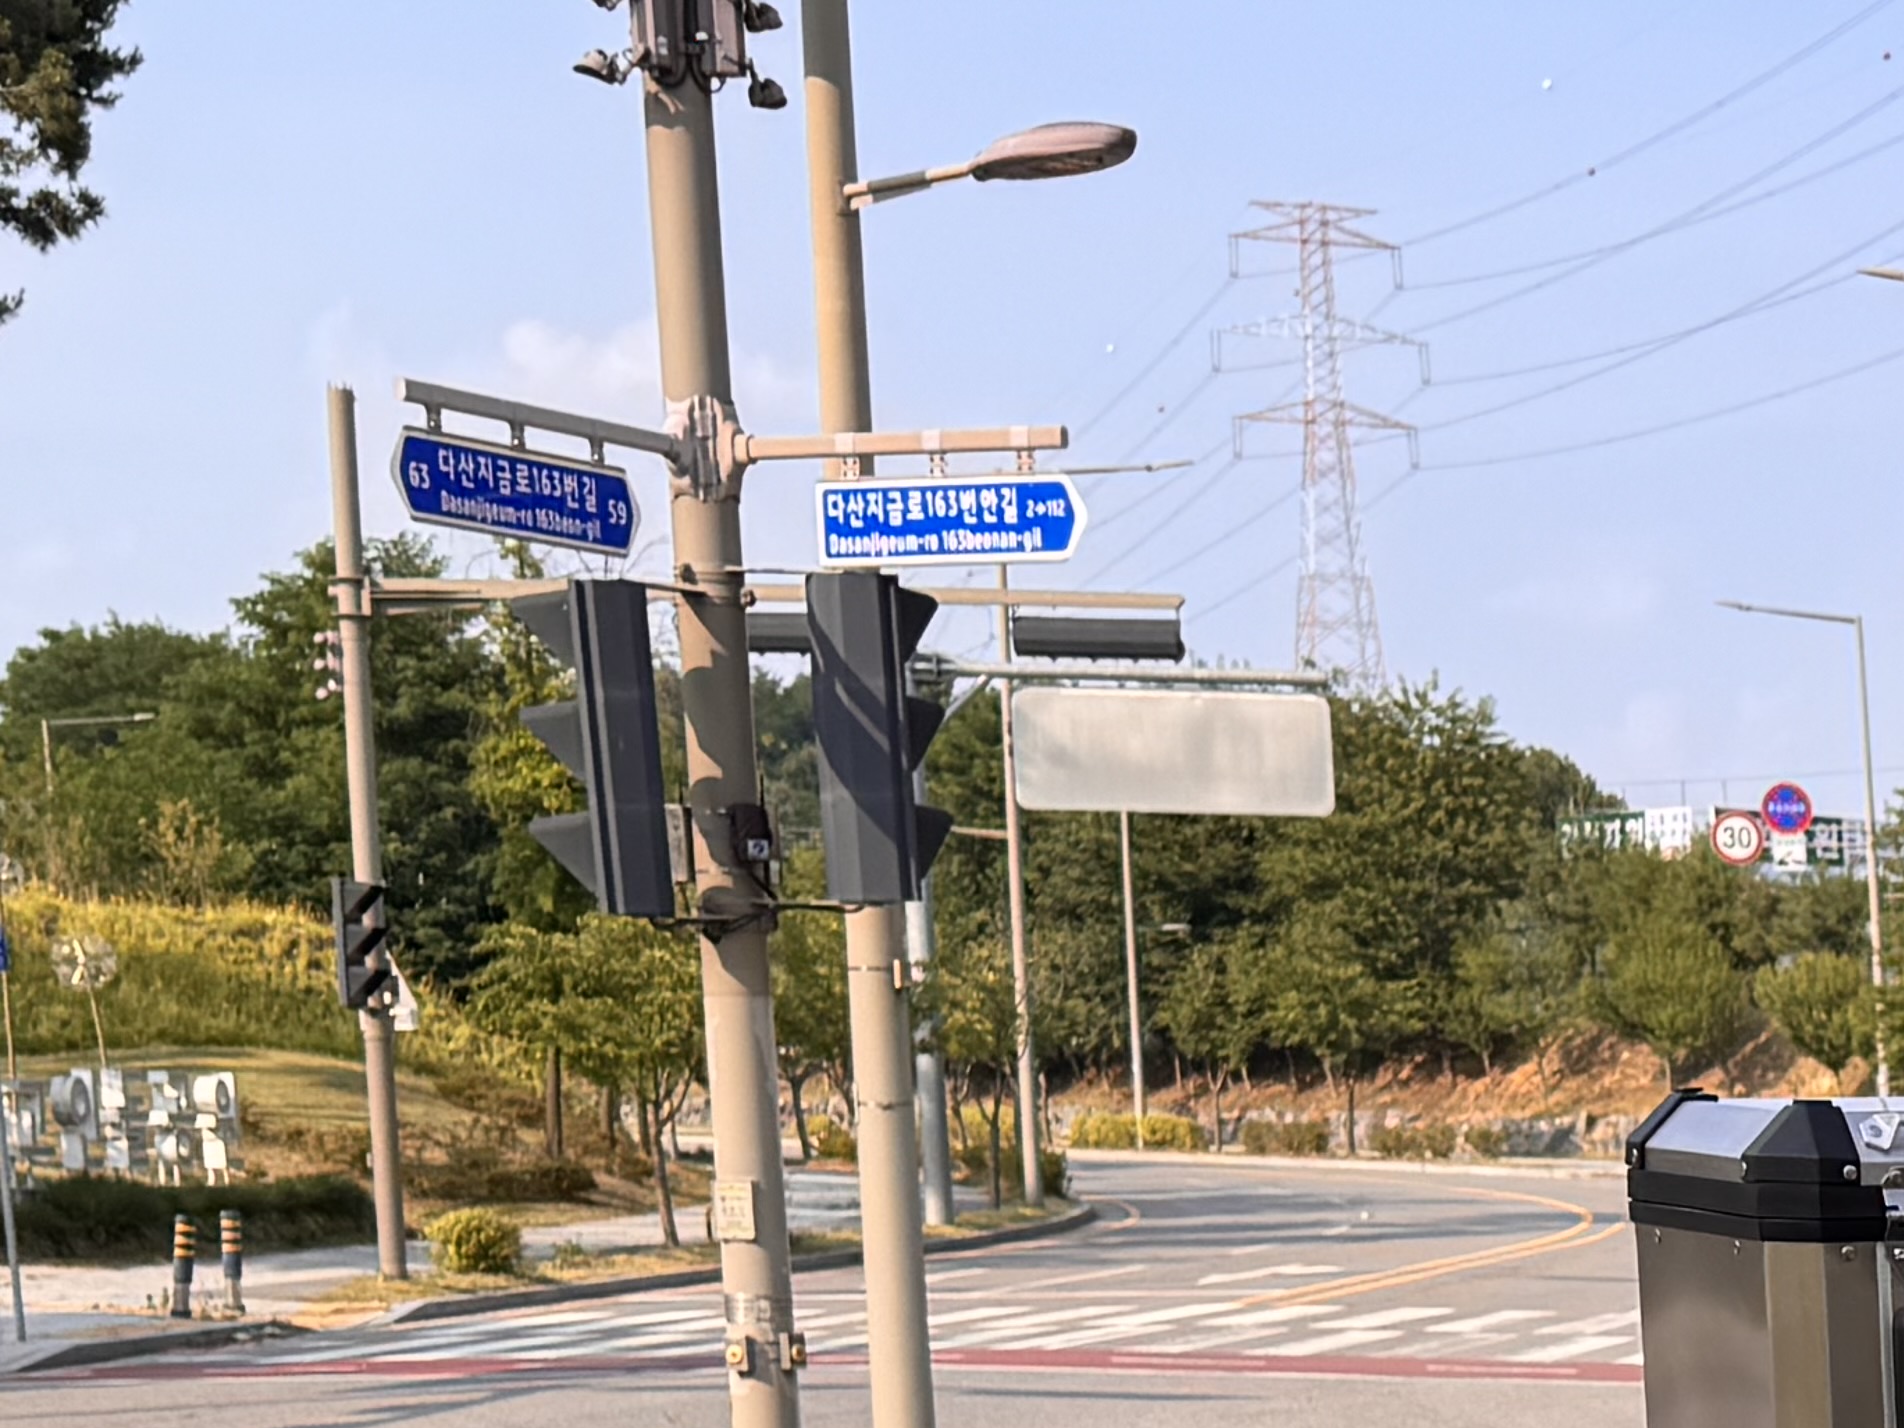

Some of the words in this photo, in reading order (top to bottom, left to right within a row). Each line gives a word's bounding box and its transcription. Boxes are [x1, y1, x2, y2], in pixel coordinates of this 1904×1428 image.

[408, 461, 430, 489] 63
[438, 448, 598, 513] 다산지금로163번길
[608, 499, 628, 525] 59
[826, 486, 1018, 528] 다산지금로163번안길
[828, 530, 939, 557] Dasanjigeum-ro
[1722, 826, 1752, 849] 30
